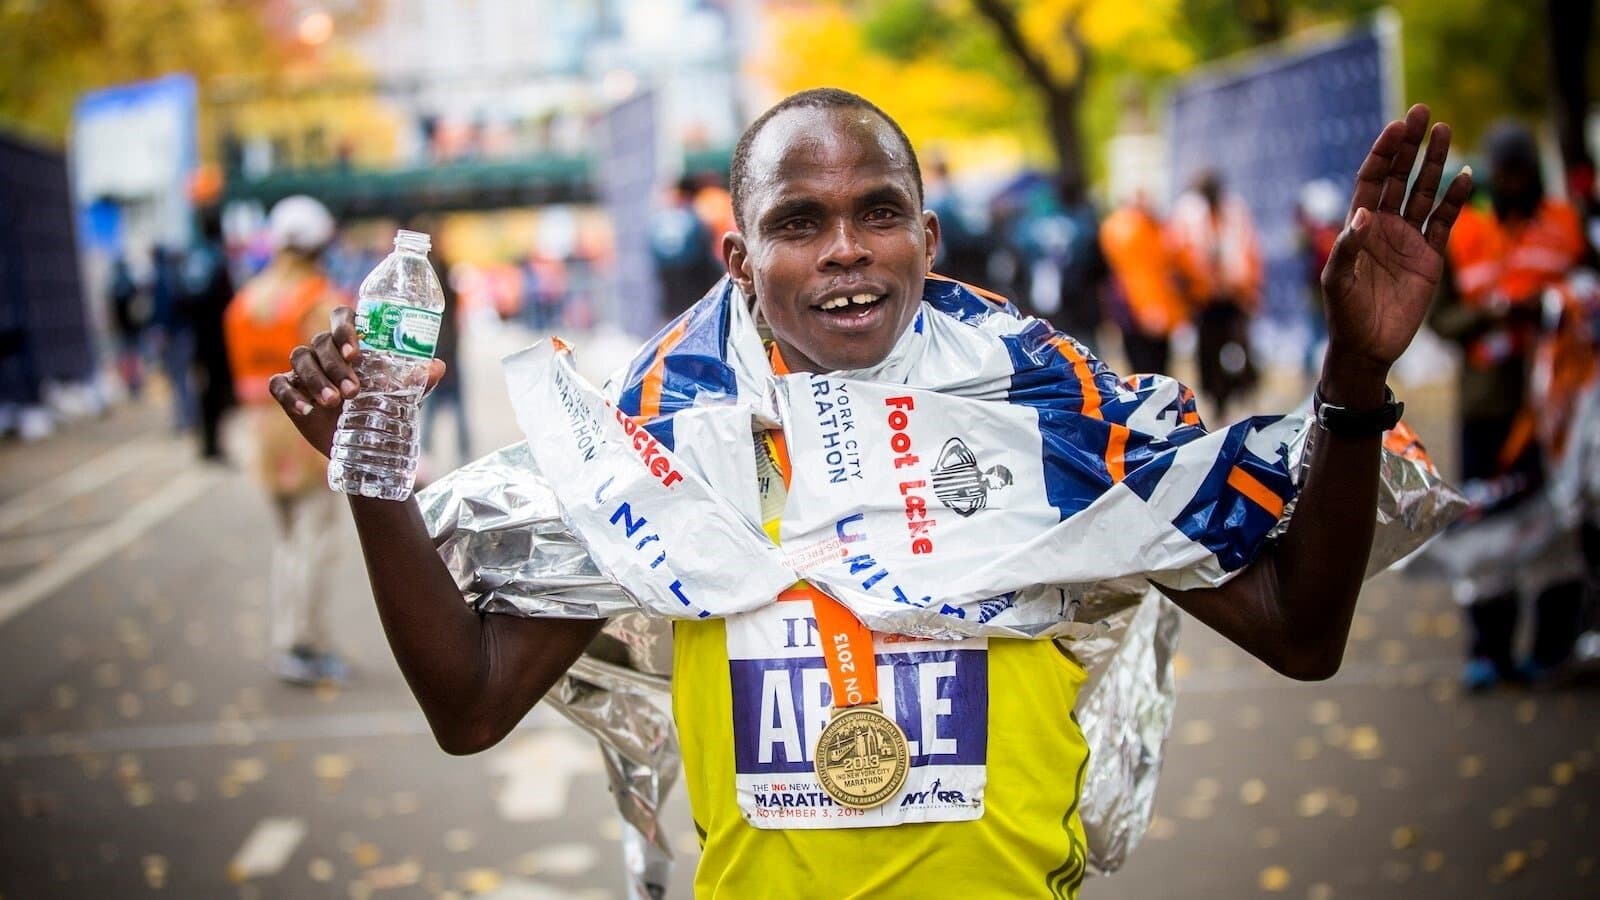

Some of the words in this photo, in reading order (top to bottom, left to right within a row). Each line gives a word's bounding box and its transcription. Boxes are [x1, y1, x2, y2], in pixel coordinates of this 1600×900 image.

[810, 374, 848, 485] RATHON
[835, 383, 855, 431] YORK
[845, 440, 863, 480] CITY
[885, 396, 920, 469] Foot
[899, 479, 936, 555] Locke
[782, 617, 820, 648] IN
[833, 632, 855, 673] 2013
[844, 678, 862, 706] ON
[855, 714, 879, 723] QUEENS
[843, 755, 880, 772] 2013
[847, 771, 859, 779] NEW
[860, 769, 875, 778] YORK
[877, 767, 890, 775] CITY
[752, 784, 769, 792] THE
[789, 783, 810, 791] NEW
[844, 776, 883, 788] MARATHON
[754, 793, 843, 808] MARATH
[756, 808, 816, 818] NOVEMBER
[822, 809, 832, 818] 3,
[837, 807, 865, 817] 2013
